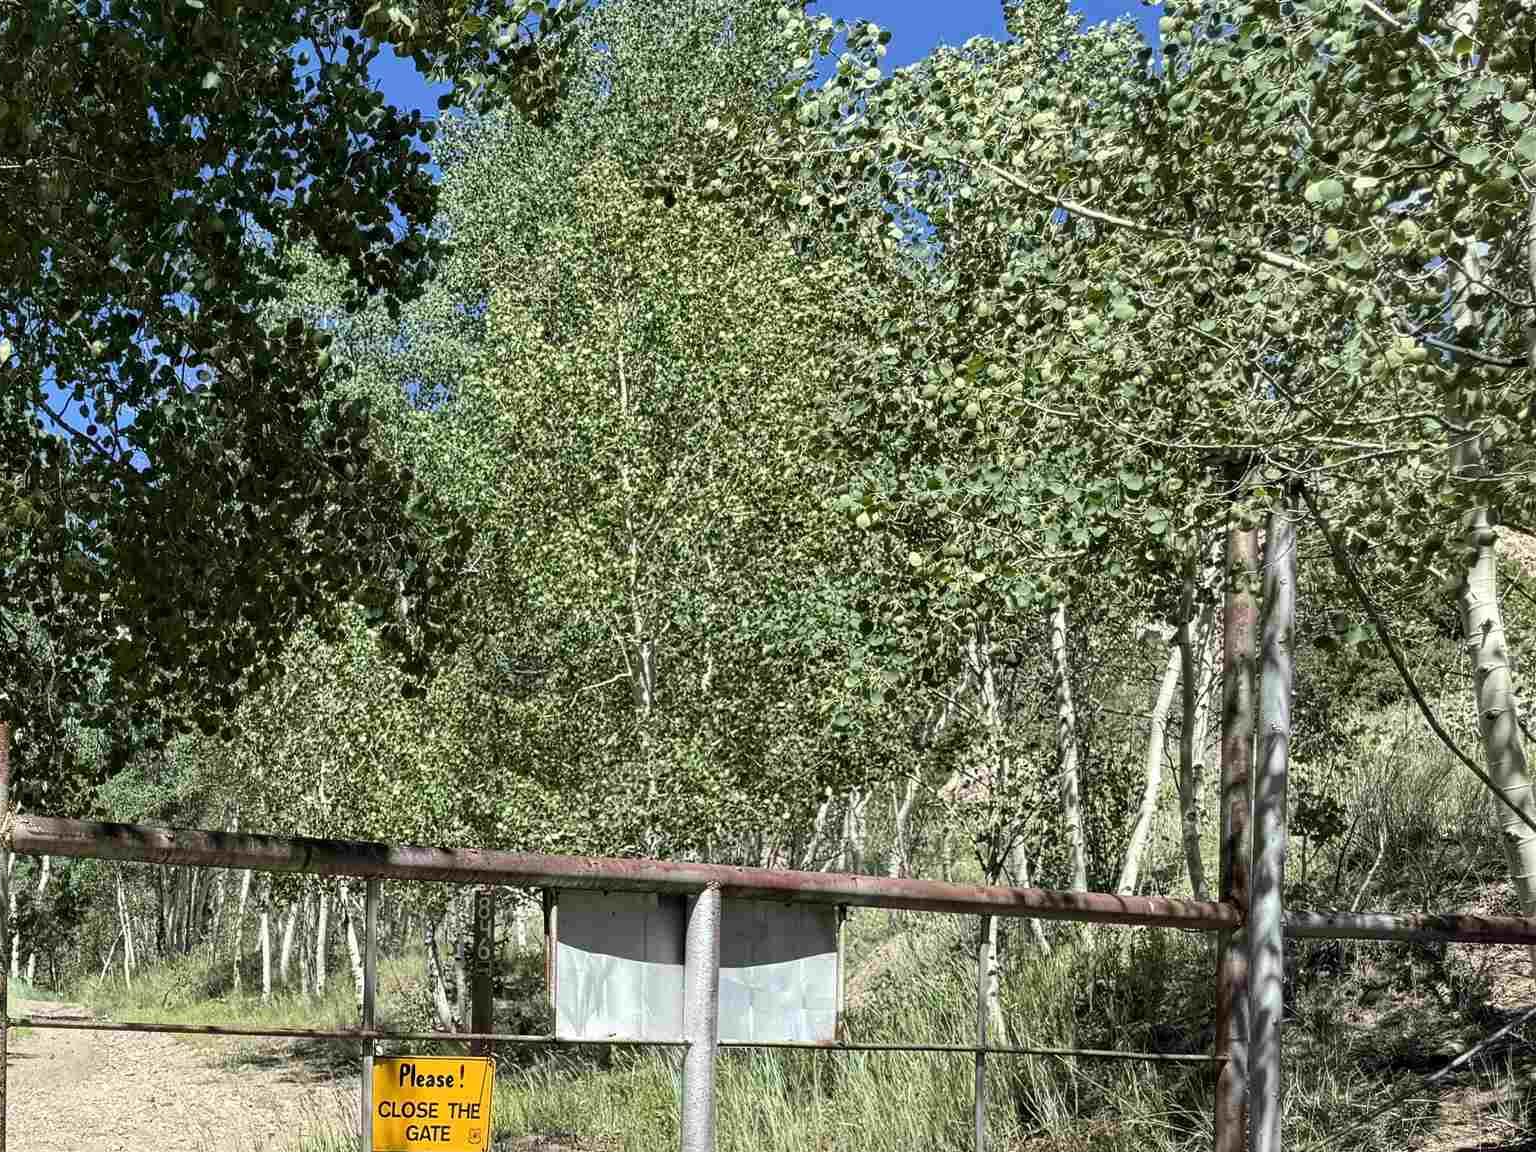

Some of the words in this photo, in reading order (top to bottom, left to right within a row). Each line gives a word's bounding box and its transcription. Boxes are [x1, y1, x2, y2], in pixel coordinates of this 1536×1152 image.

[378, 1101, 439, 1118] CLOSE
[448, 1102, 481, 1119] THE
[405, 1125, 451, 1141] GATE
